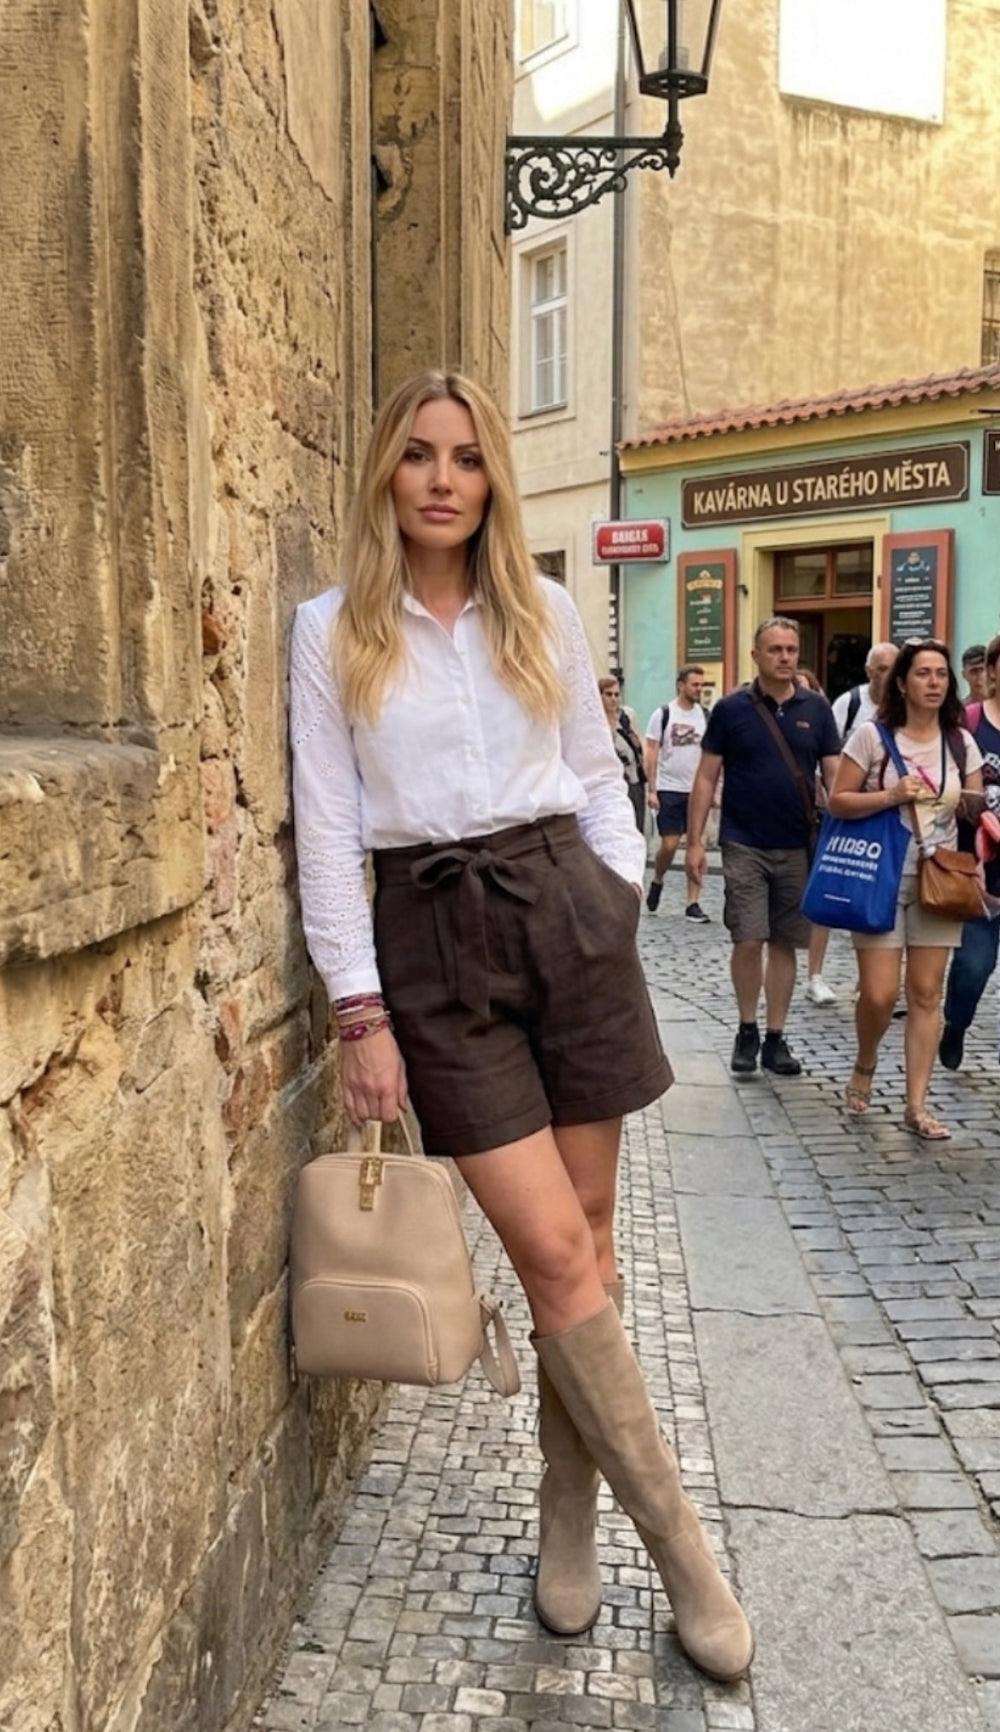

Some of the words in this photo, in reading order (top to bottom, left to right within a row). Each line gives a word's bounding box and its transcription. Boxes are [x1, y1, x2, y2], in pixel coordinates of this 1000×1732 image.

[693, 481, 773, 515] KAVÁRNA
[776, 480, 789, 506] U
[792, 466, 879, 504] STARÉHO
[883, 459, 951, 494] MĚSTA
